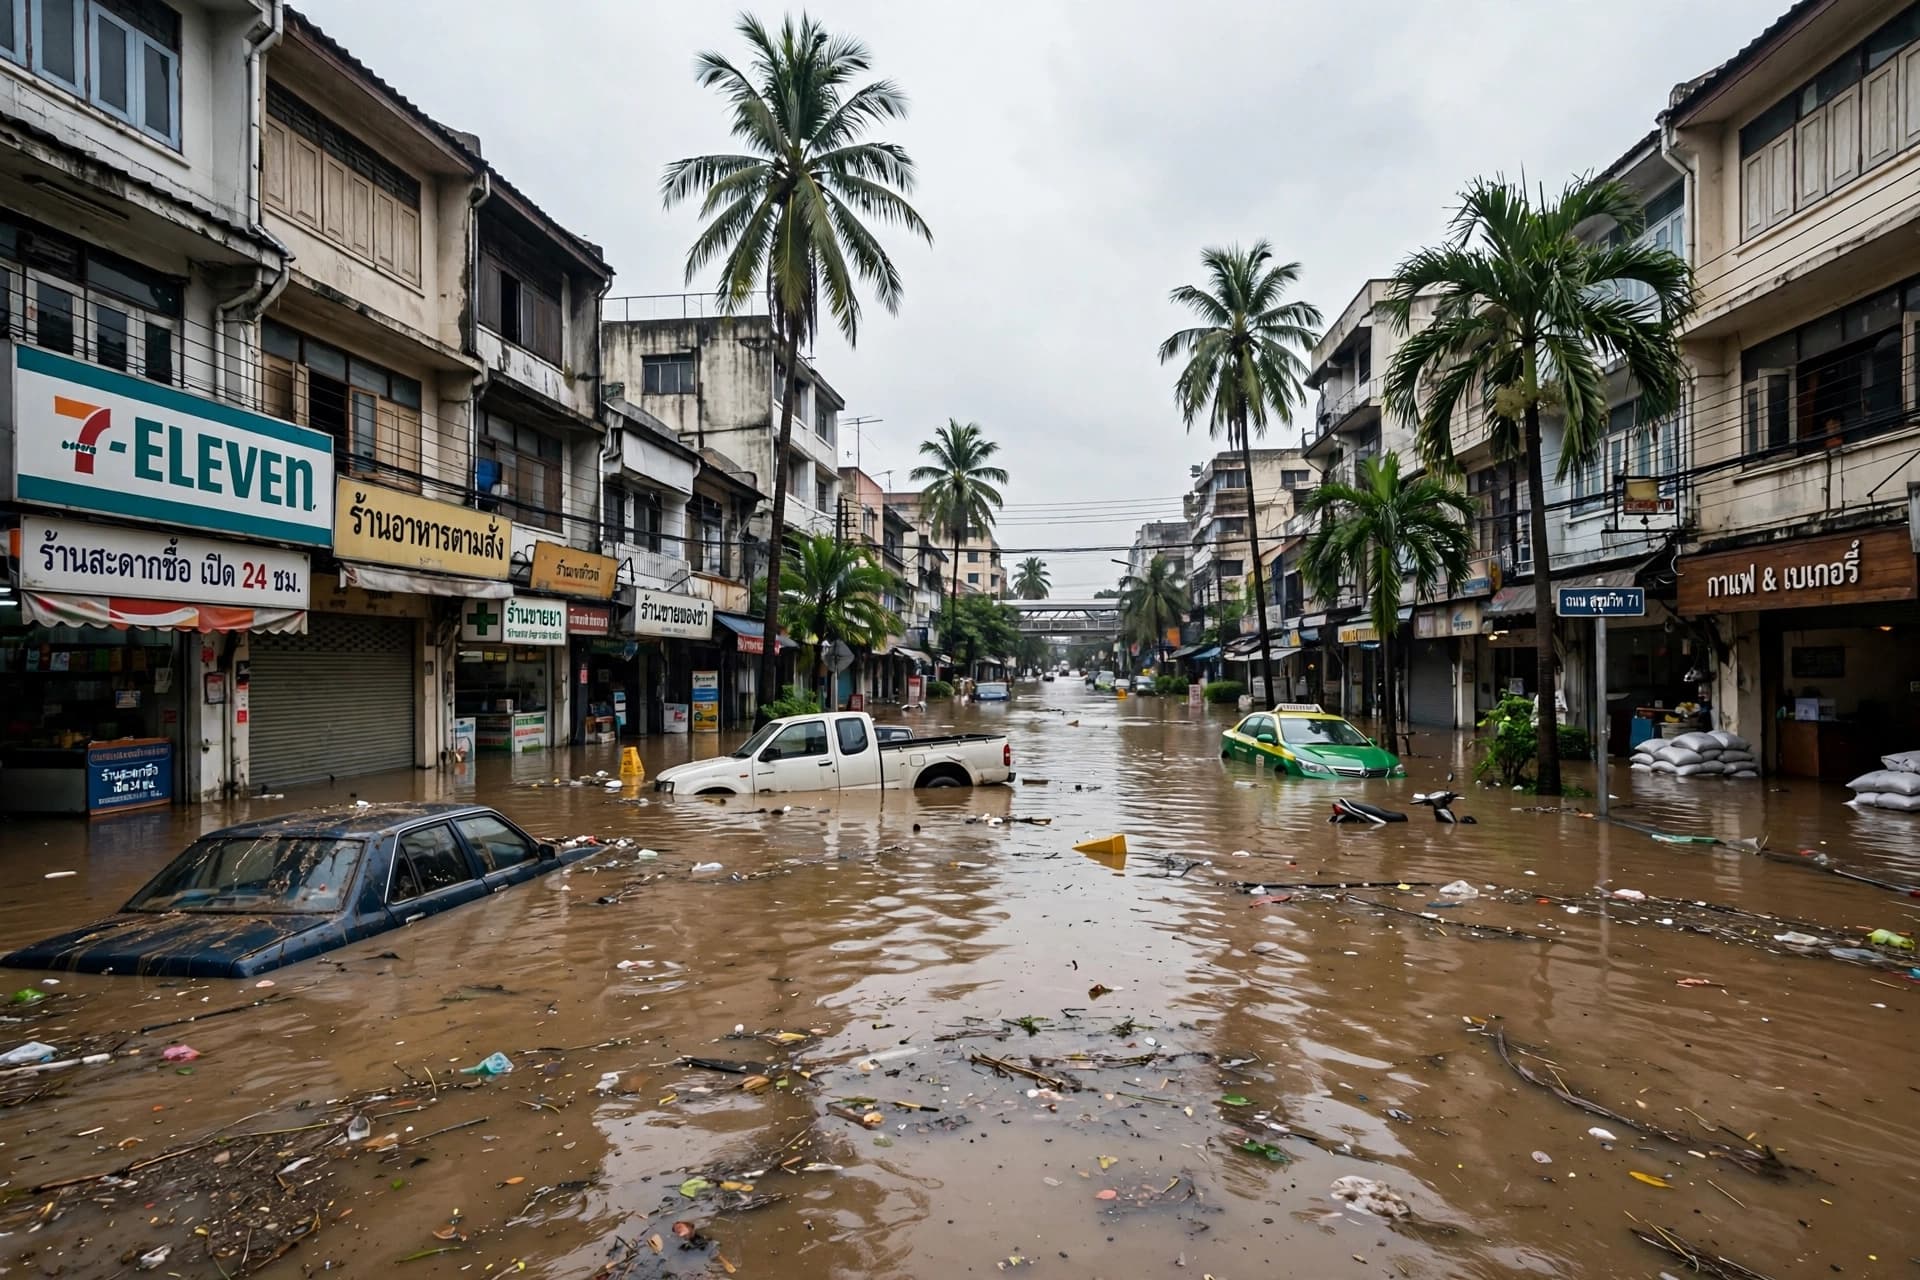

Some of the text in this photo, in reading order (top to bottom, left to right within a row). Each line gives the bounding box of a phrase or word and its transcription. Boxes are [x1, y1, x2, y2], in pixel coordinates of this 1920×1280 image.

[350, 492, 504, 560] ร้านอาหารตามสั่ง
[201, 553, 235, 587] เปิด
[242, 562, 267, 589] 24
[274, 570, 301, 592] ชม.
[1707, 564, 1755, 597] กาแฟ
[1762, 567, 1777, 591] &
[507, 600, 562, 627] ร้านขายยา
[1627, 594, 1639, 607] 71
